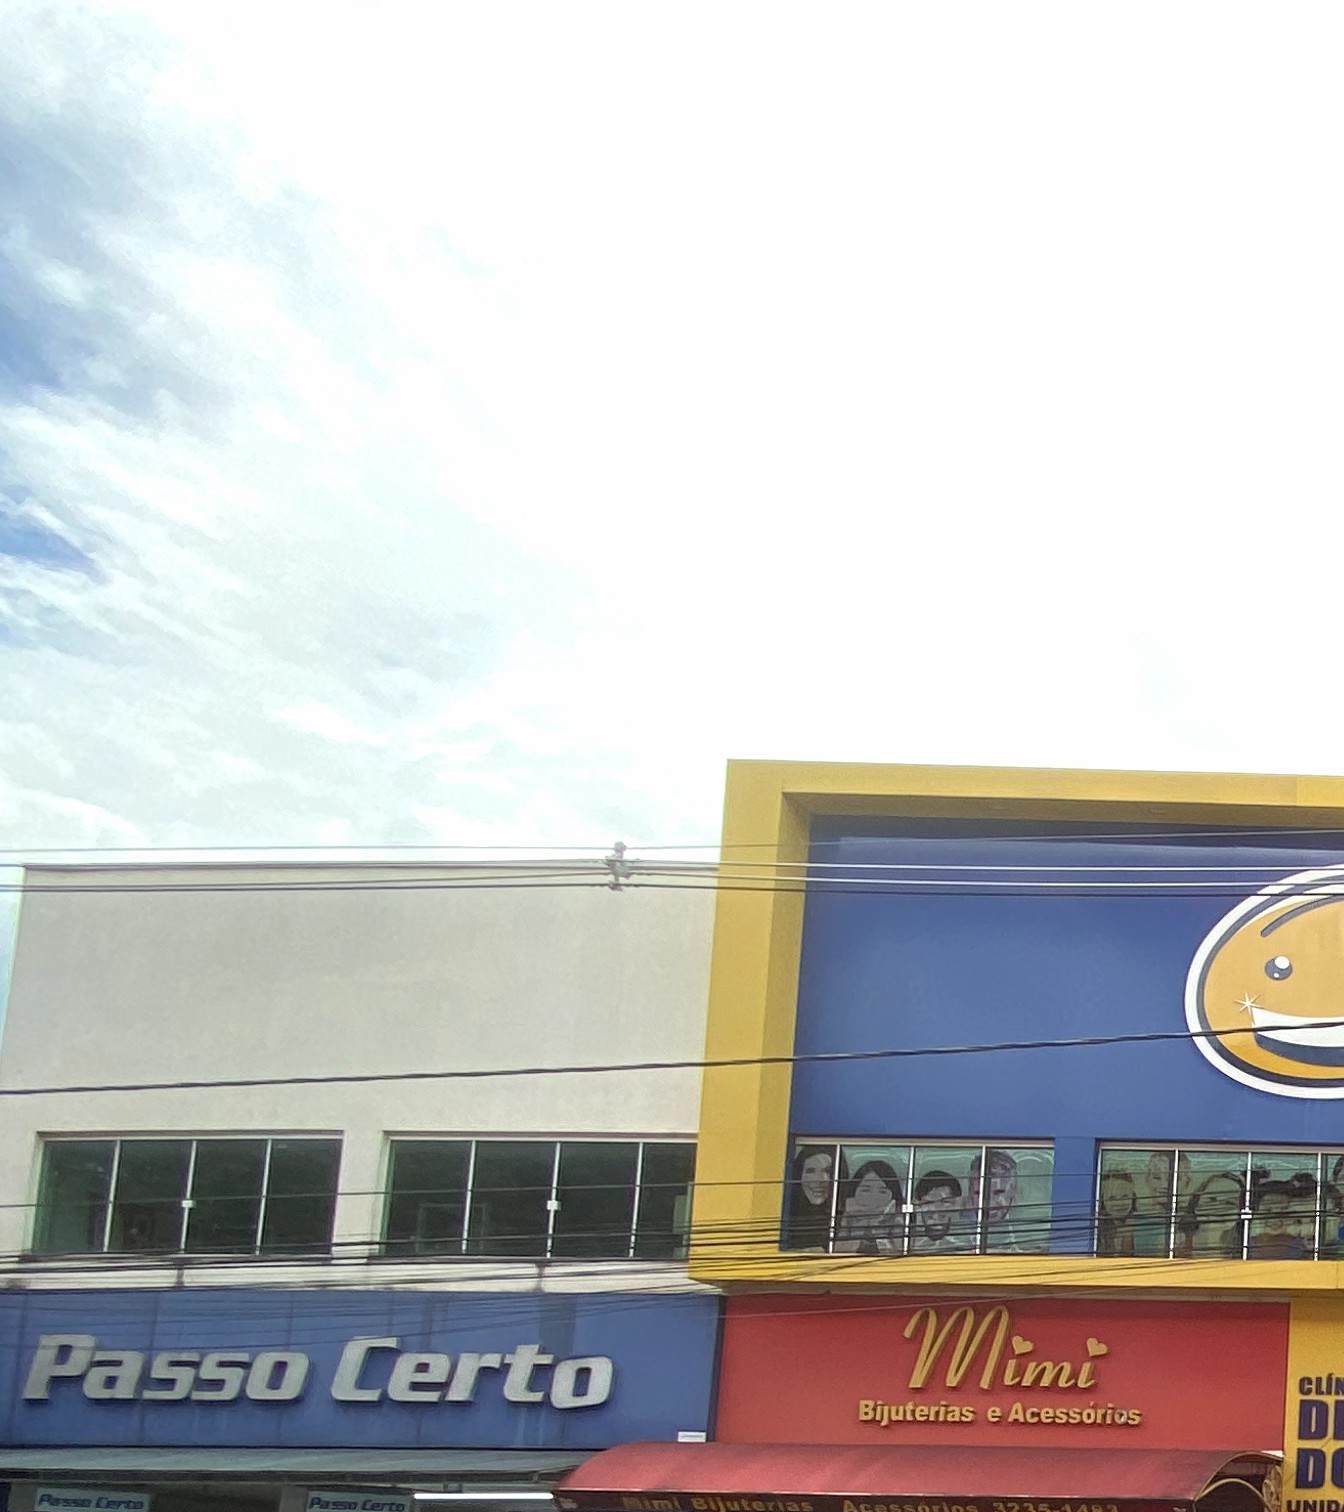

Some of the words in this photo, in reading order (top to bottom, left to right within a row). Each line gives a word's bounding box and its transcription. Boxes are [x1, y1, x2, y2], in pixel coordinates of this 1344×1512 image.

[904, 1304, 1110, 1390] Mimi
[22, 1334, 309, 1401] Passo
[330, 1336, 614, 1409] Certo
[859, 1400, 975, 1427] Bijuterias
[987, 1406, 1001, 1423] e
[1009, 1401, 1142, 1426] Acessórios
[308, 1496, 358, 1511] Passo
[361, 1499, 405, 1512] Certo
[623, 1496, 680, 1511] Mimi
